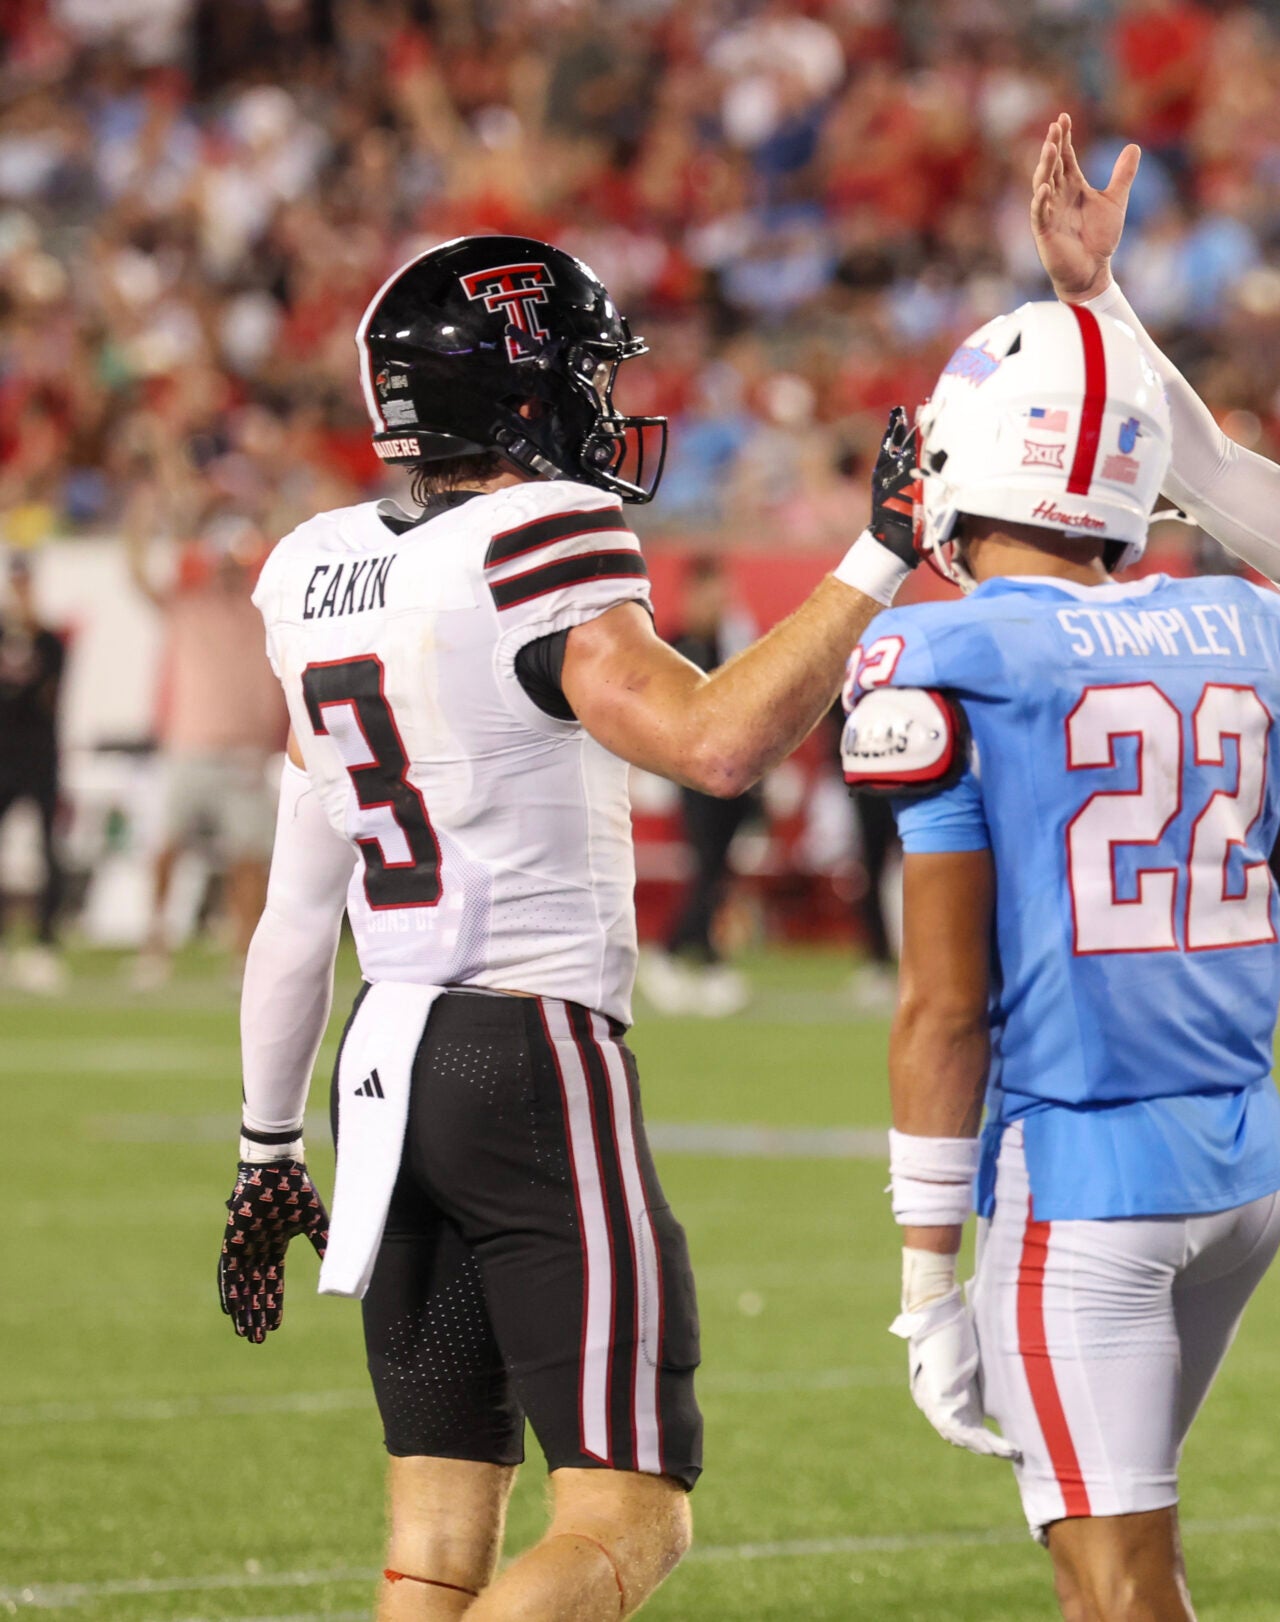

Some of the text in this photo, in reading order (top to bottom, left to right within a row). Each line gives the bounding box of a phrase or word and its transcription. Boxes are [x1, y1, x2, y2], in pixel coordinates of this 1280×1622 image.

[1032, 500, 1106, 530] Houston
[303, 553, 398, 620] EAKIN
[1056, 603, 1248, 657] STAMPLEY
[302, 652, 443, 912] 3
[1064, 681, 1279, 957] 22
